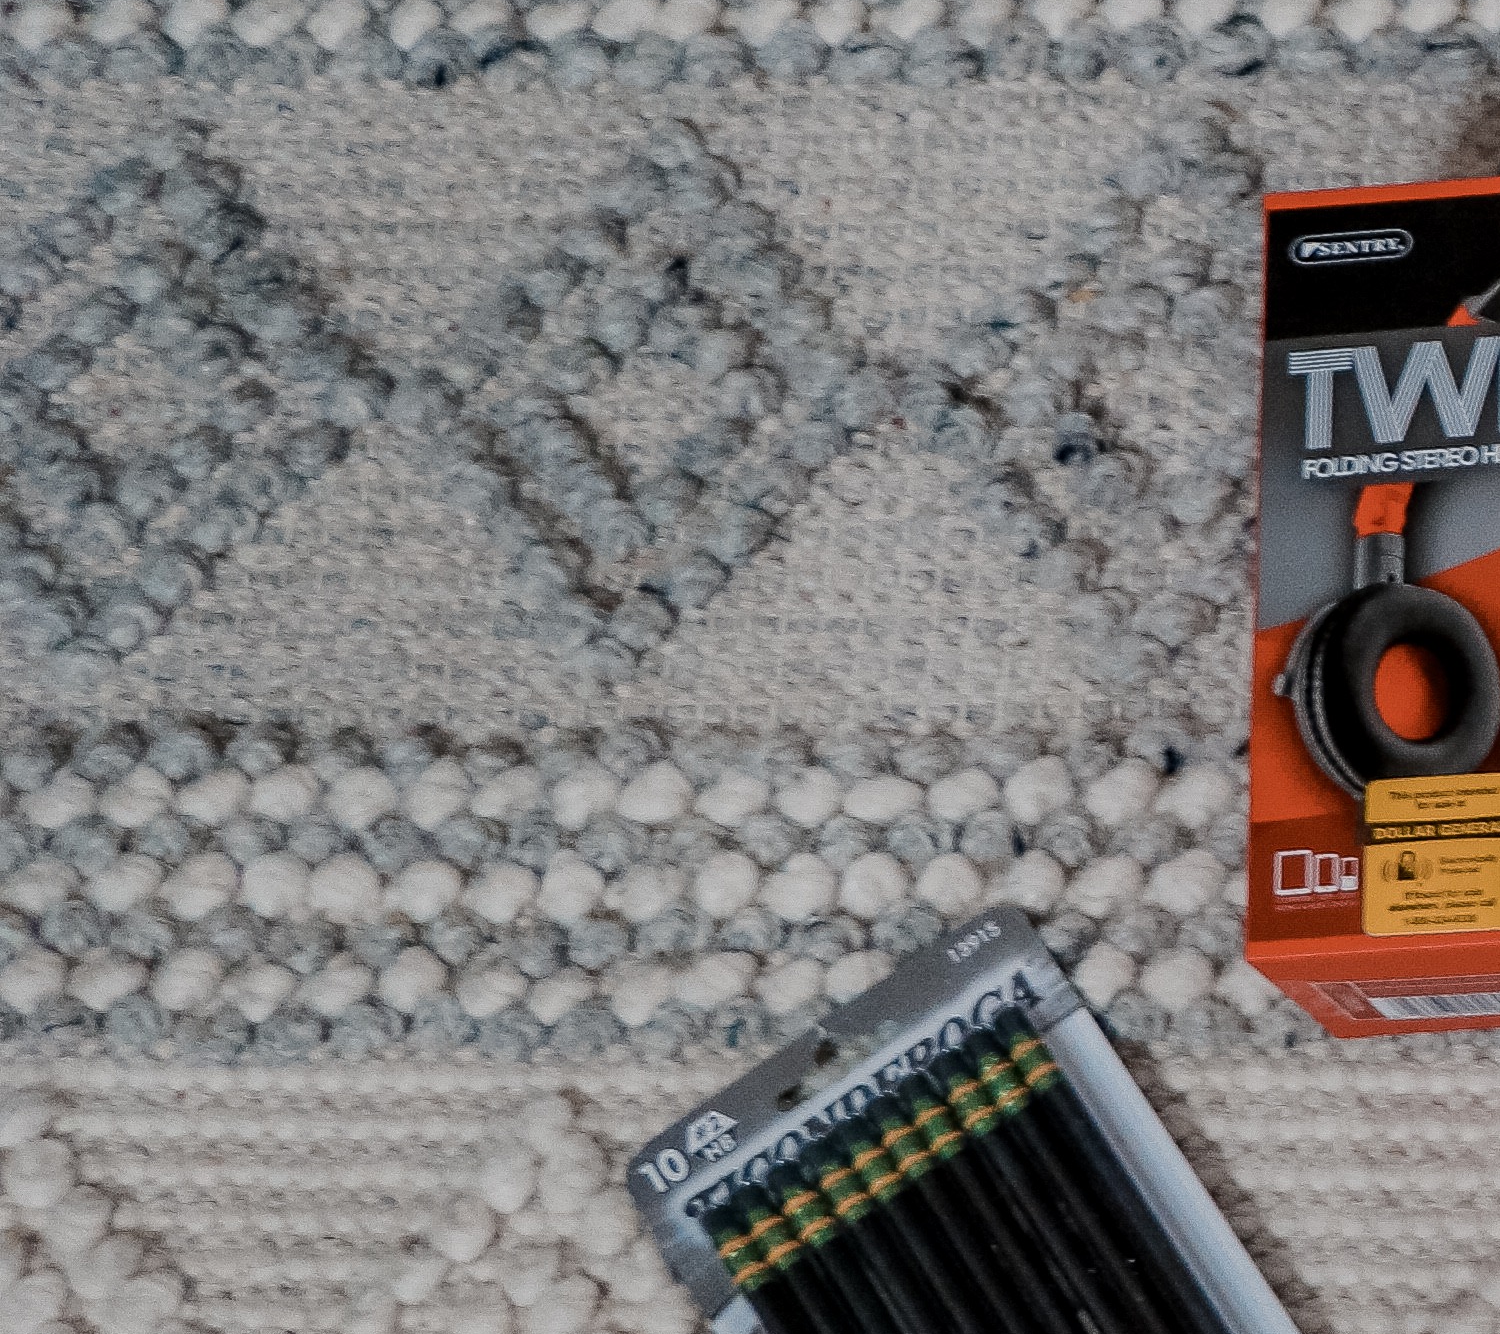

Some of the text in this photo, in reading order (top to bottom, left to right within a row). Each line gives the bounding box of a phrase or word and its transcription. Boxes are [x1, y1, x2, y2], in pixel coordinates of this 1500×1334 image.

[1317, 238, 1405, 256] SENTRY
[1303, 453, 1399, 480] FOLDING
[1400, 445, 1480, 470] STEREO
[637, 1147, 690, 1194] 10
